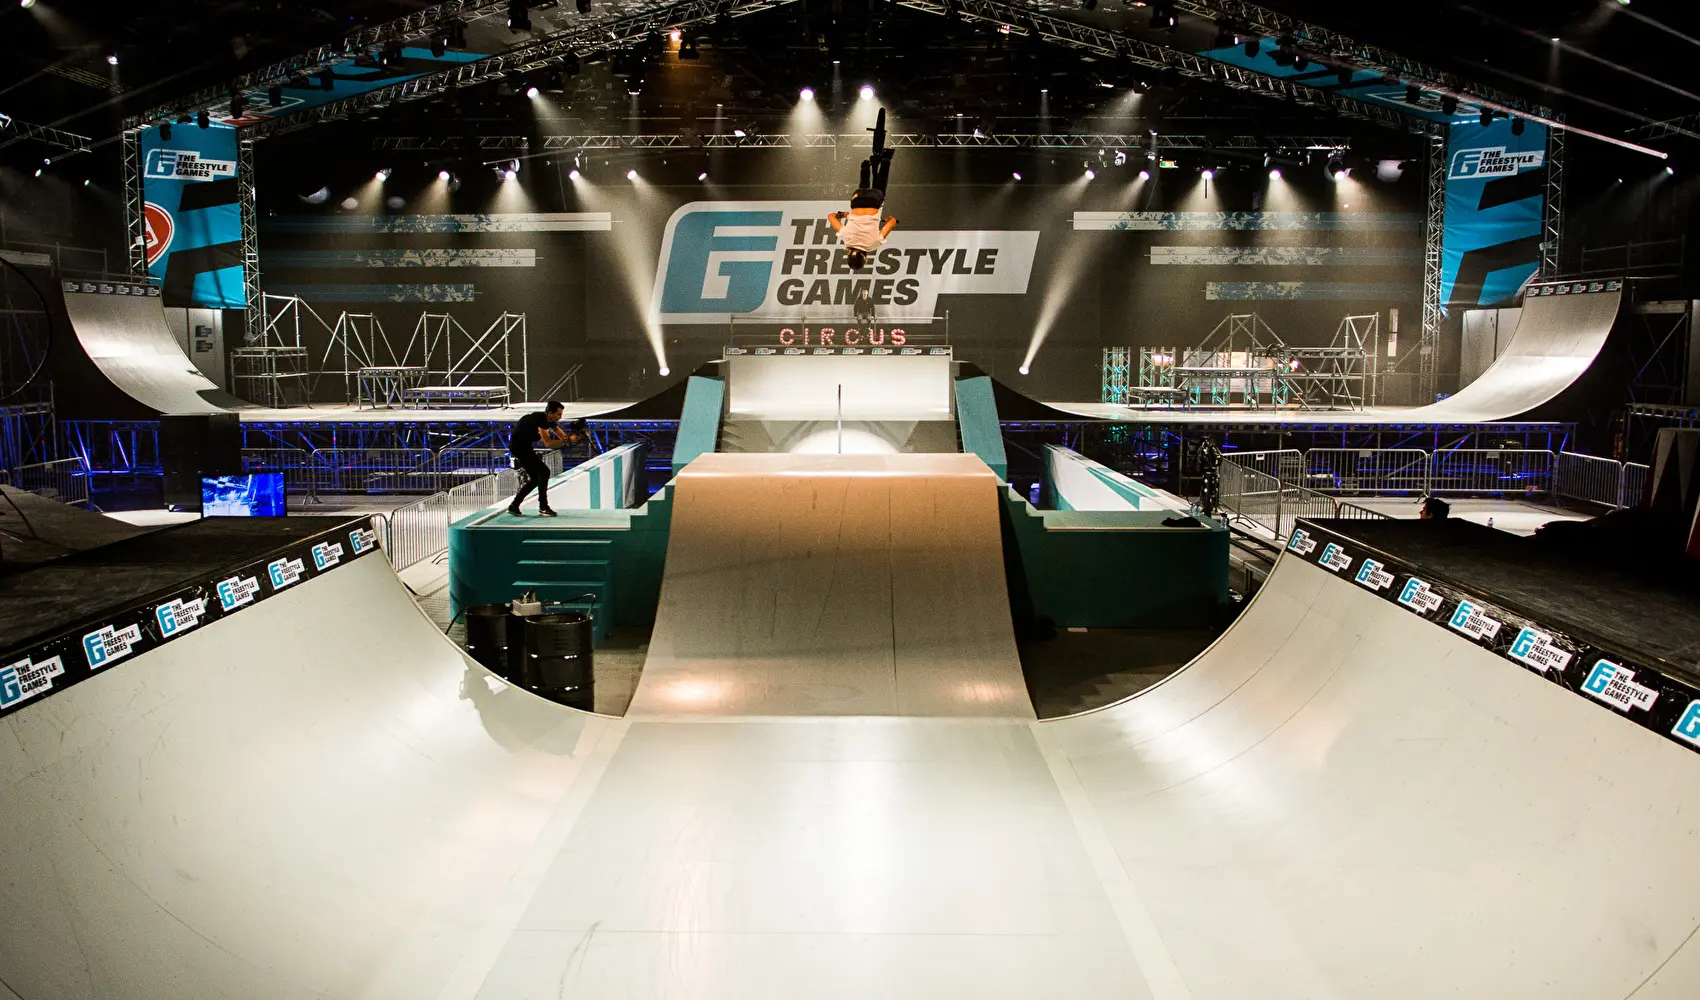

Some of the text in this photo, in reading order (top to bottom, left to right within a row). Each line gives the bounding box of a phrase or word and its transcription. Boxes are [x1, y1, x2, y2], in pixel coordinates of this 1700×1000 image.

[178, 154, 196, 162] THE
[1480, 155, 1534, 166] FREESTYLE
[176, 162, 228, 172] FREESTYLE
[176, 168, 210, 177] GAMES
[1479, 164, 1514, 173] GAMES
[791, 218, 848, 245] TH
[781, 248, 998, 275] FREESTYLE
[777, 278, 919, 306] GAMES
[779, 327, 906, 346] CIRCUS
[232, 582, 254, 594] FREESTYLE
[235, 591, 250, 602] GAMES
[1414, 590, 1438, 606] FREESTYLE
[172, 604, 182, 612] THE
[1412, 598, 1427, 608] GAMES
[174, 604, 200, 620] FREESTYLE
[1472, 609, 1482, 617] THE
[176, 615, 194, 626] GAMES
[1468, 615, 1494, 632] FREESTYLE
[1464, 622, 1482, 634] GAMES
[102, 630, 114, 640] THE
[104, 630, 136, 648] FREESTYLE
[1536, 636, 1548, 646] THE
[106, 642, 128, 656] GAMES
[1532, 644, 1564, 664] FREESTYLE
[1527, 652, 1550, 666] GAMES
[16, 664, 30, 676] THE
[18, 663, 57, 684] FREESTYLE
[1614, 672, 1630, 684] THE
[22, 677, 48, 693] GAMES
[1608, 680, 1649, 702] FREESTYLE
[1604, 688, 1630, 705] GAMES
